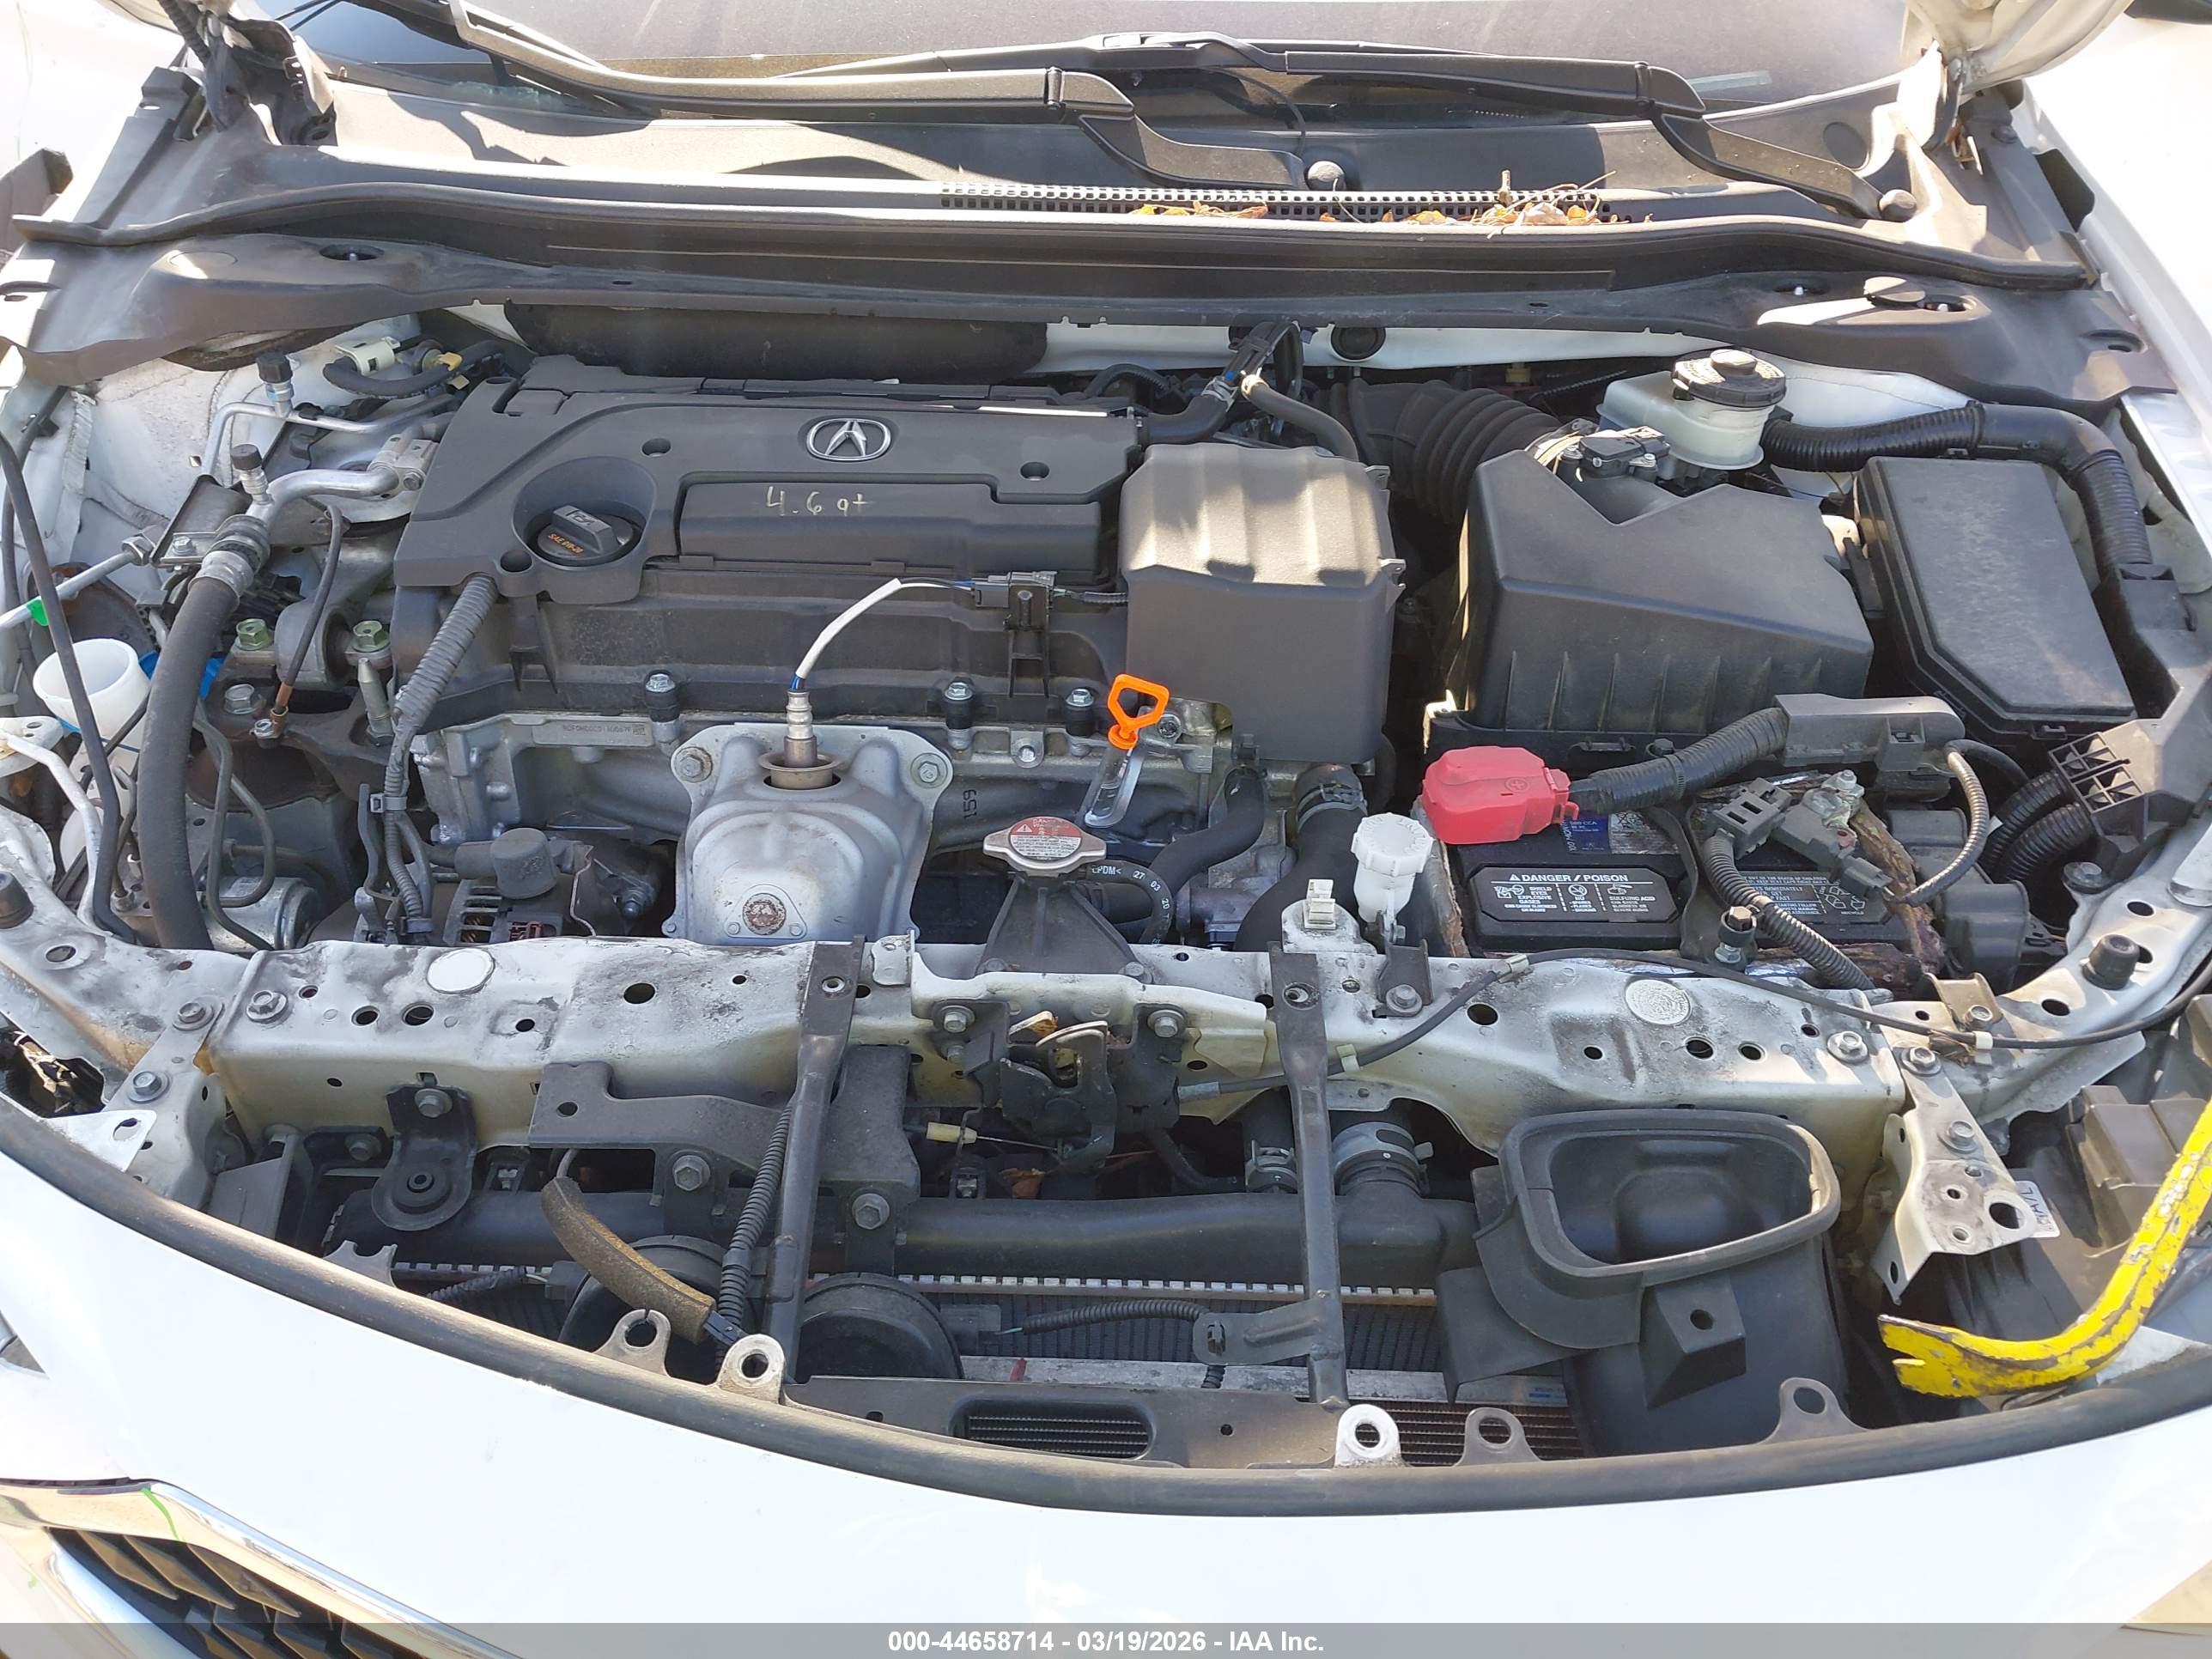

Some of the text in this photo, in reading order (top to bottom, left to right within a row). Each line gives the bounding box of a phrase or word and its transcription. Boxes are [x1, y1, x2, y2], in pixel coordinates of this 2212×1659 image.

[547, 532, 564, 544] SAE
[963, 789, 976, 818] 159
[1133, 870, 1146, 879] 27
[1150, 880, 1161, 891] 03
[1161, 897, 1170, 909] 20
